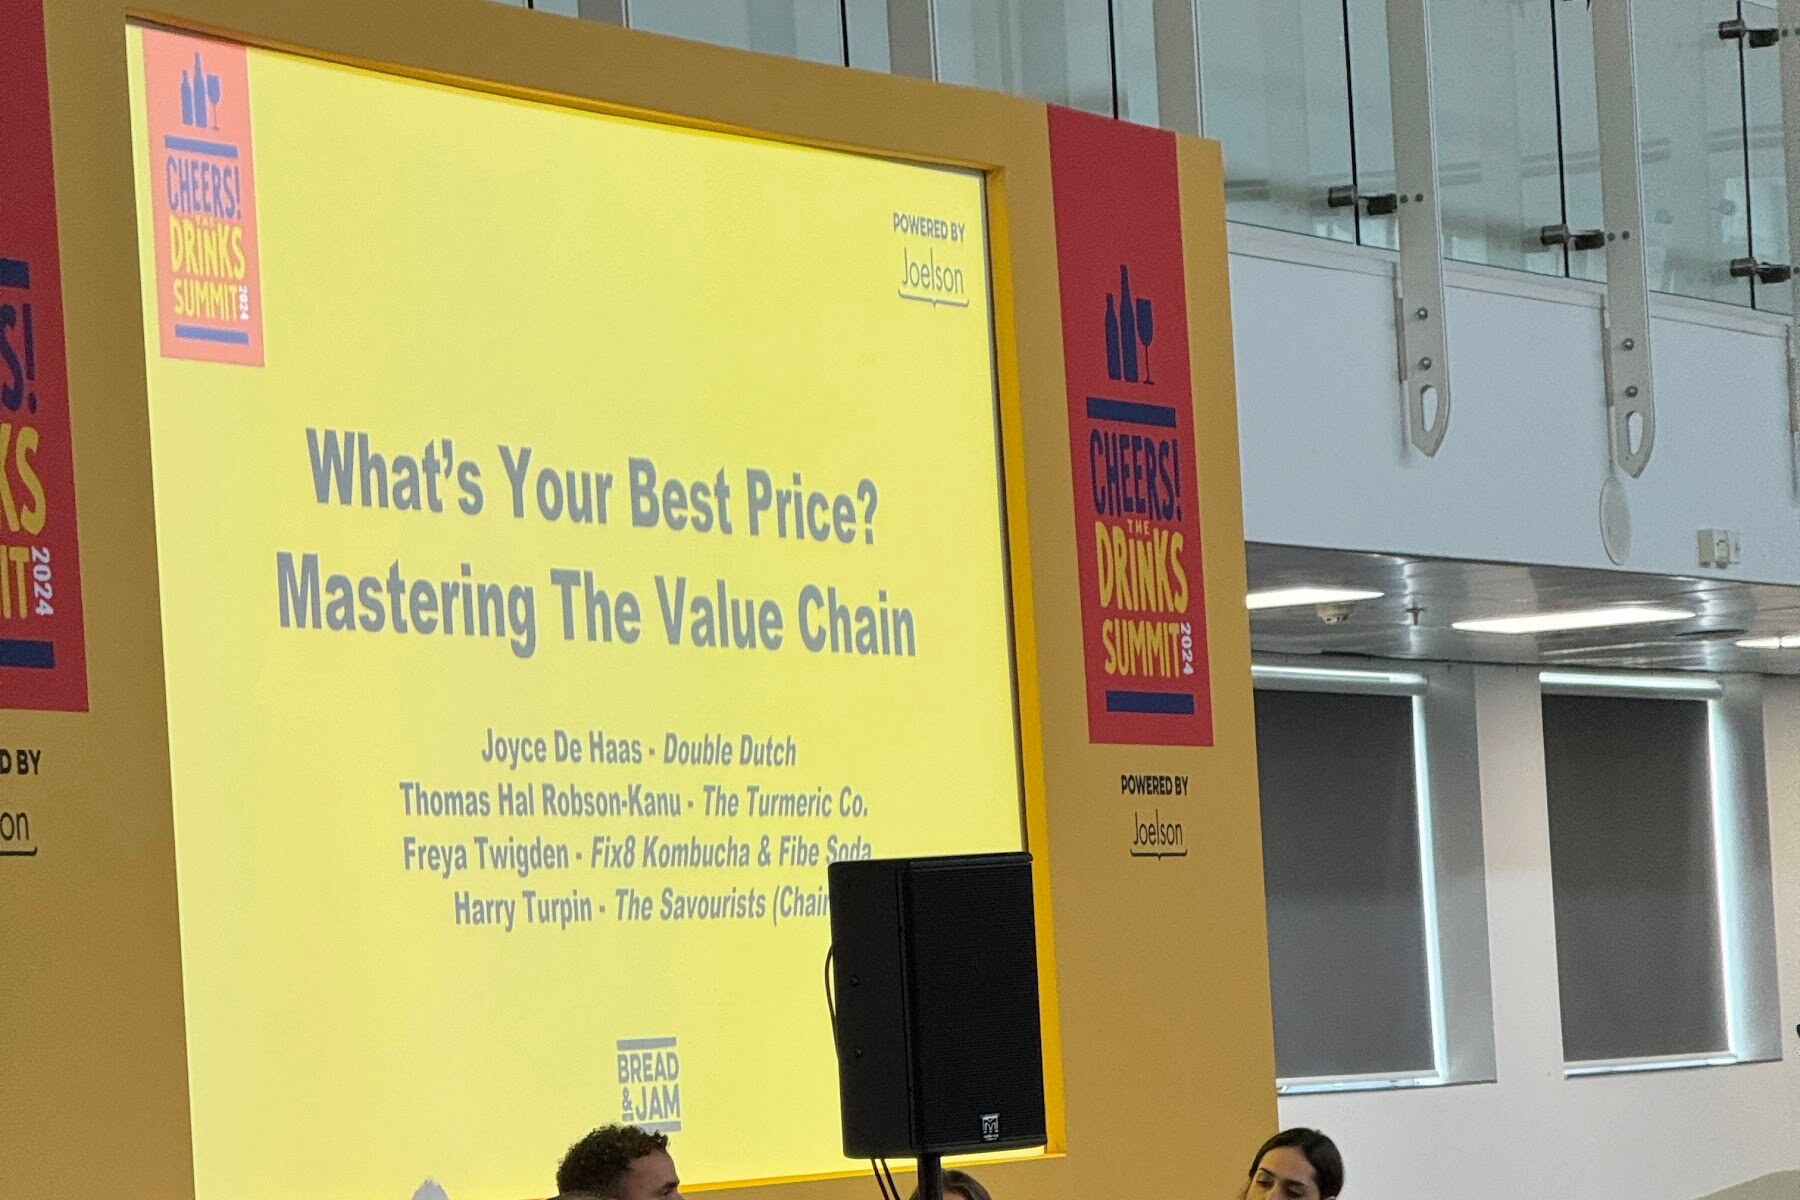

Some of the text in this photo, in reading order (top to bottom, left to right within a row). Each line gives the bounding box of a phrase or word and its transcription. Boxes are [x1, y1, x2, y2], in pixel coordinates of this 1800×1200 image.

[166, 156, 242, 219] CHEERS!
[169, 214, 246, 279] DRINKS
[893, 212, 966, 243] POWERED BY
[902, 246, 964, 294] Joelson
[173, 279, 239, 321] SUMMIT
[238, 285, 249, 320] 2024
[305, 426, 878, 545] What's Your Best Price?
[1090, 429, 1182, 522] CHEERS!
[1127, 519, 1150, 535] THE
[31, 546, 53, 616] 2024
[1095, 521, 1189, 614] DRINKS
[276, 551, 916, 659] Mastering The Value Chain
[1102, 618, 1180, 678] SUMMIT
[1180, 622, 1194, 676] 2024
[16, 750, 41, 775] BY
[481, 728, 547, 770] Joyce
[554, 729, 582, 764] De
[589, 730, 643, 764] Haas
[663, 732, 733, 766] Double
[739, 734, 797, 766] Dutch
[399, 782, 491, 817] Thomas
[497, 783, 535, 817] Hal
[541, 783, 682, 817] Robson-Kanu
[703, 785, 739, 817] The
[747, 785, 833, 818] Turmeric
[839, 786, 868, 817] Co.
[1121, 774, 1189, 796] POWERED BY
[1133, 809, 1183, 845] Joelson
[403, 836, 468, 879] Freya
[473, 835, 569, 878] Twigden
[591, 835, 636, 868] Fix8
[642, 835, 751, 868] Kombucha
[757, 834, 771, 867] &
[778, 835, 820, 867] Fibe
[826, 835, 872, 864] Soda
[454, 891, 516, 932] Harry
[522, 889, 593, 930] Turpin
[615, 888, 654, 921] The
[659, 886, 767, 921] Savourists
[616, 1051, 680, 1084] BREAD
[621, 1083, 680, 1121] & JAM
